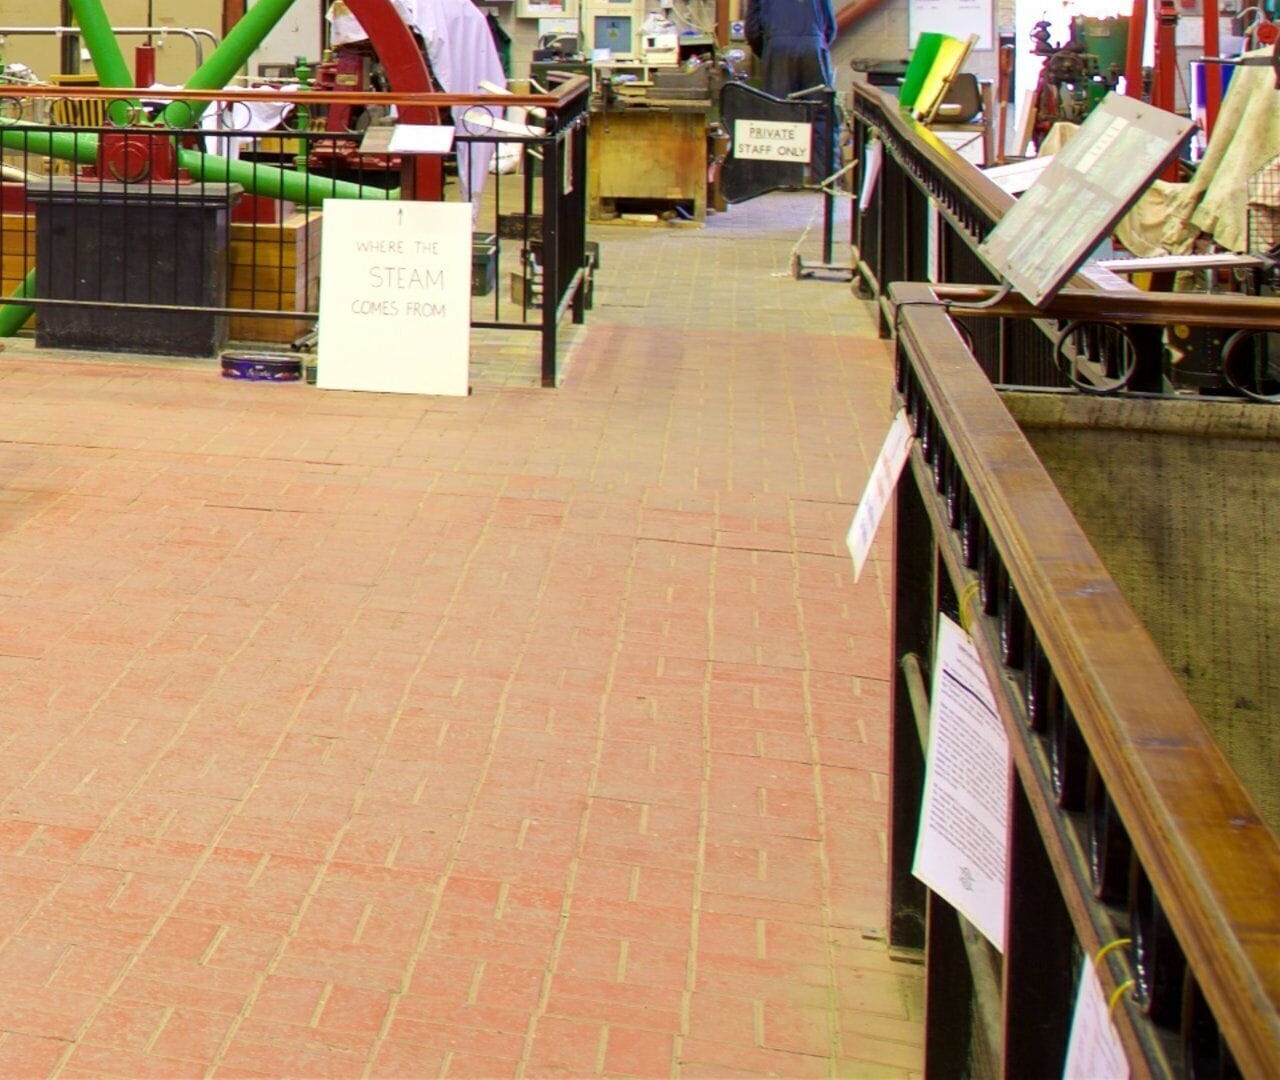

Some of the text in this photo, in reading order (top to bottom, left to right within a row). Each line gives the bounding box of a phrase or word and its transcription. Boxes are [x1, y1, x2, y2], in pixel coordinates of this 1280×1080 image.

[749, 127, 795, 139] PRIVATE
[738, 143, 807, 156] STAFF ONLY
[356, 240, 439, 255] WHERE THE
[369, 266, 445, 290] STEAM
[351, 299, 447, 318] COMES FROM
